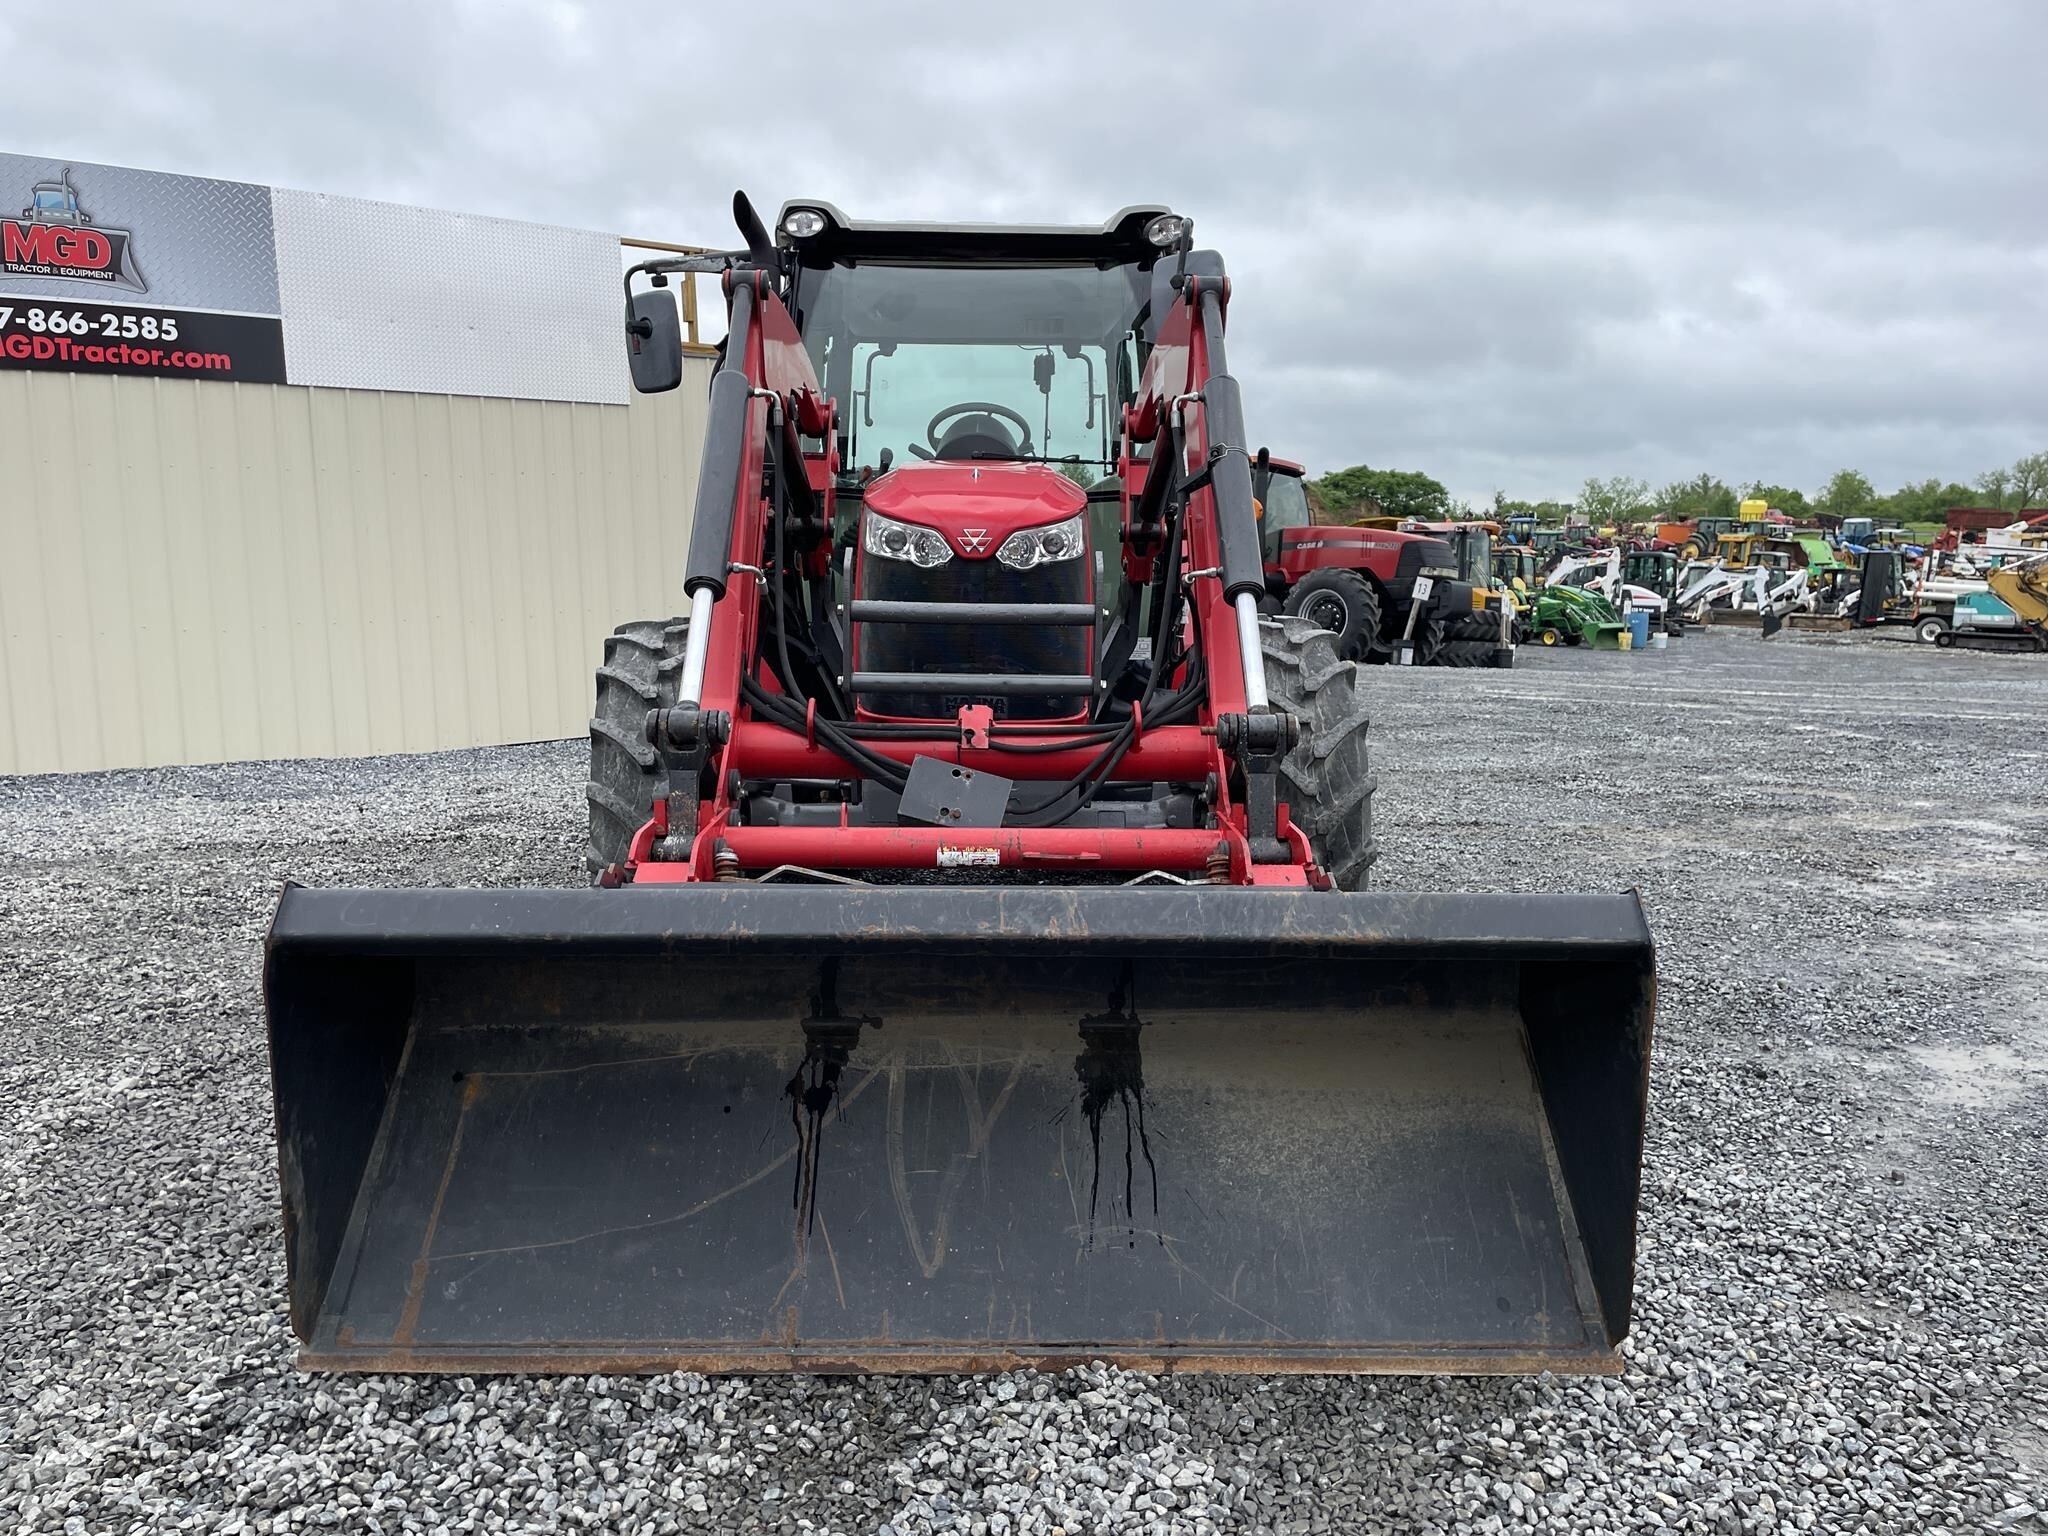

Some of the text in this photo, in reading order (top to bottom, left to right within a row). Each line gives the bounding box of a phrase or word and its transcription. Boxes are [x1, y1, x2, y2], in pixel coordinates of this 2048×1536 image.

[2, 221, 112, 269] MGD
[6, 263, 51, 274] TRACTOR
[60, 267, 113, 279] EQUIPMENT
[0, 306, 178, 341] 7-866-2585
[1296, 542, 1316, 550] CASE
[1418, 583, 1428, 595] 13
